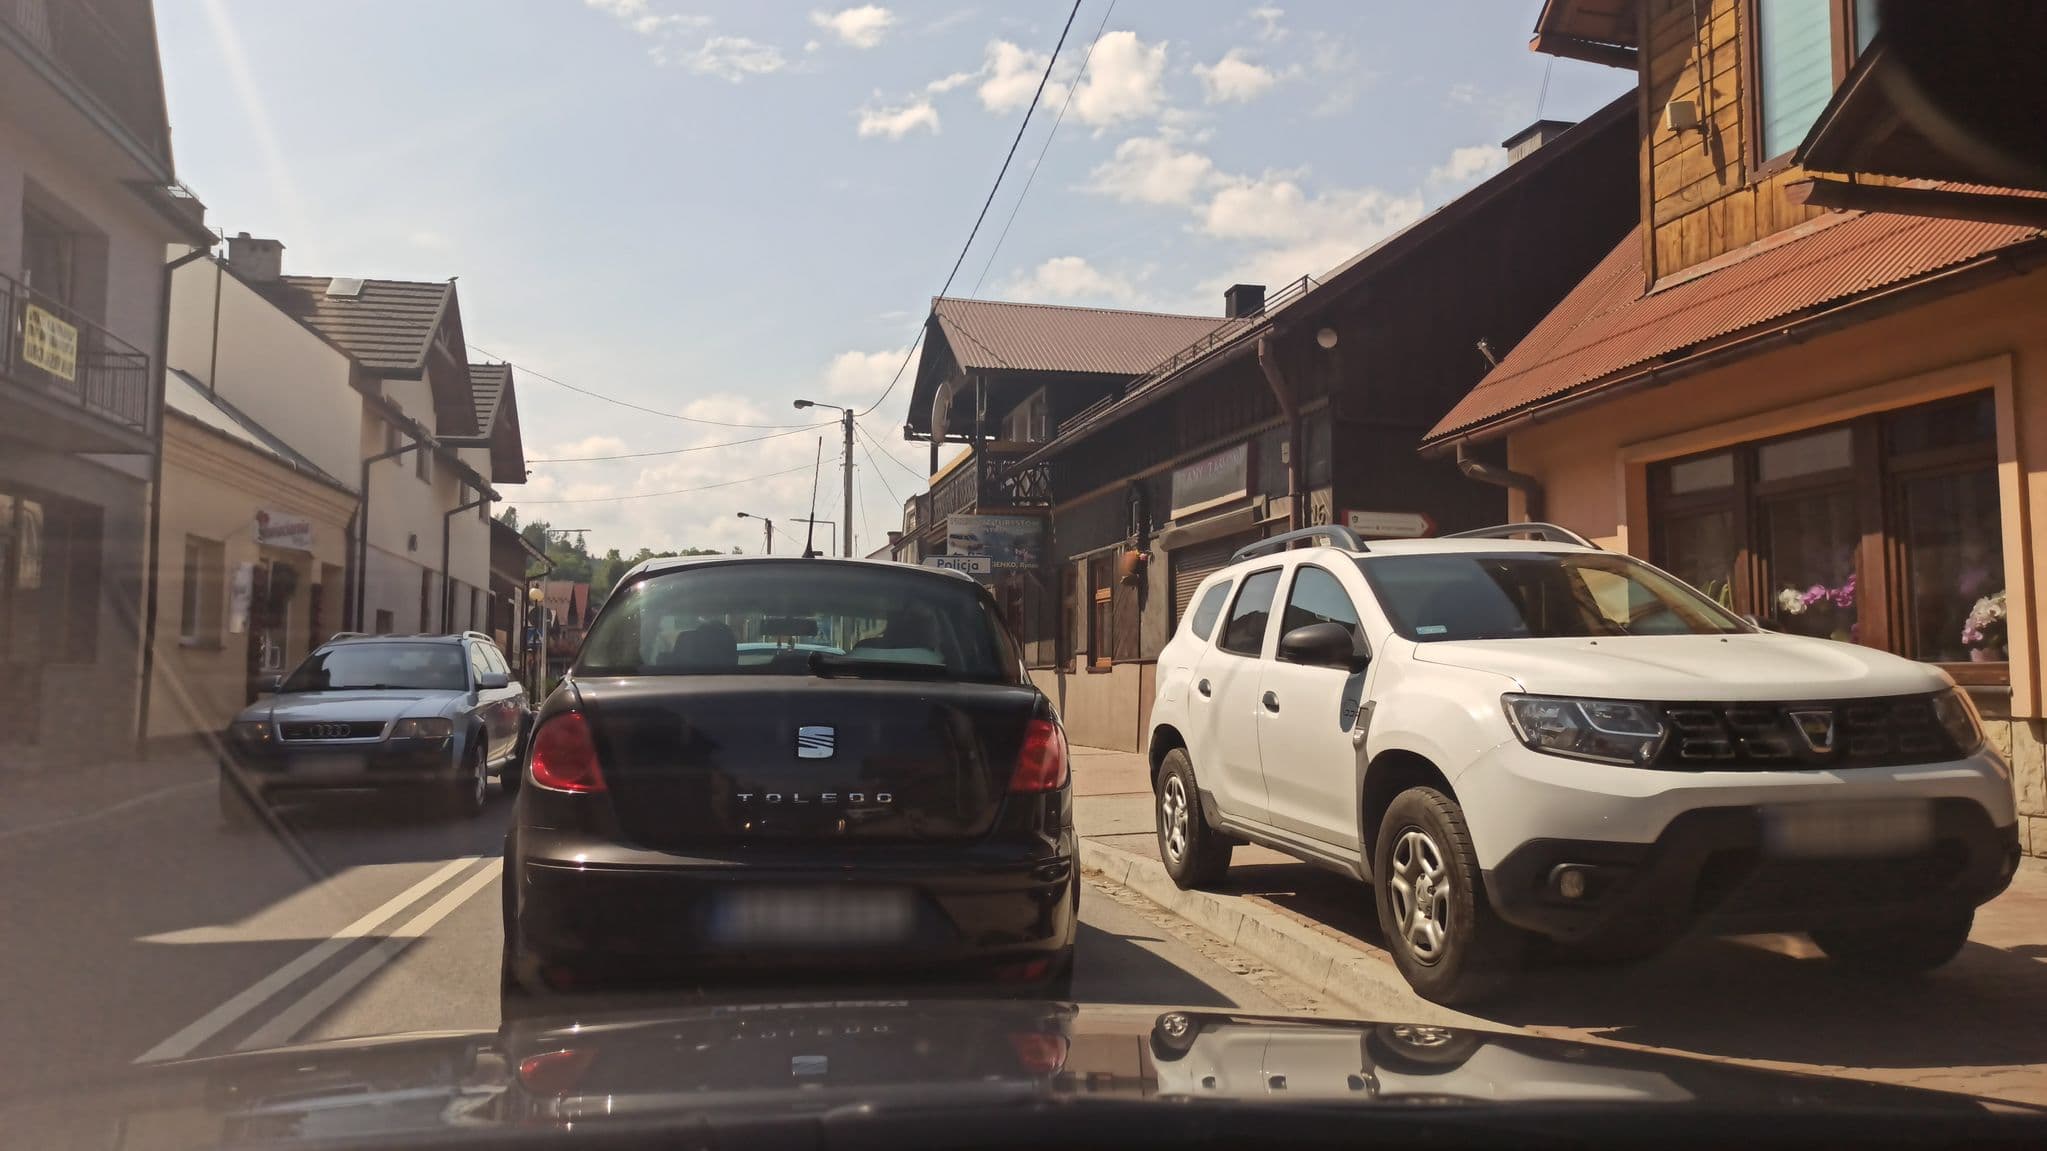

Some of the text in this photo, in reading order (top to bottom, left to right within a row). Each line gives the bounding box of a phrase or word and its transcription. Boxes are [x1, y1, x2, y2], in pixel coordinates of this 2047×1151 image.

[1312, 504, 1327, 525] 16
[937, 558, 980, 573] Policja
[737, 793, 893, 803] TOLEDO
